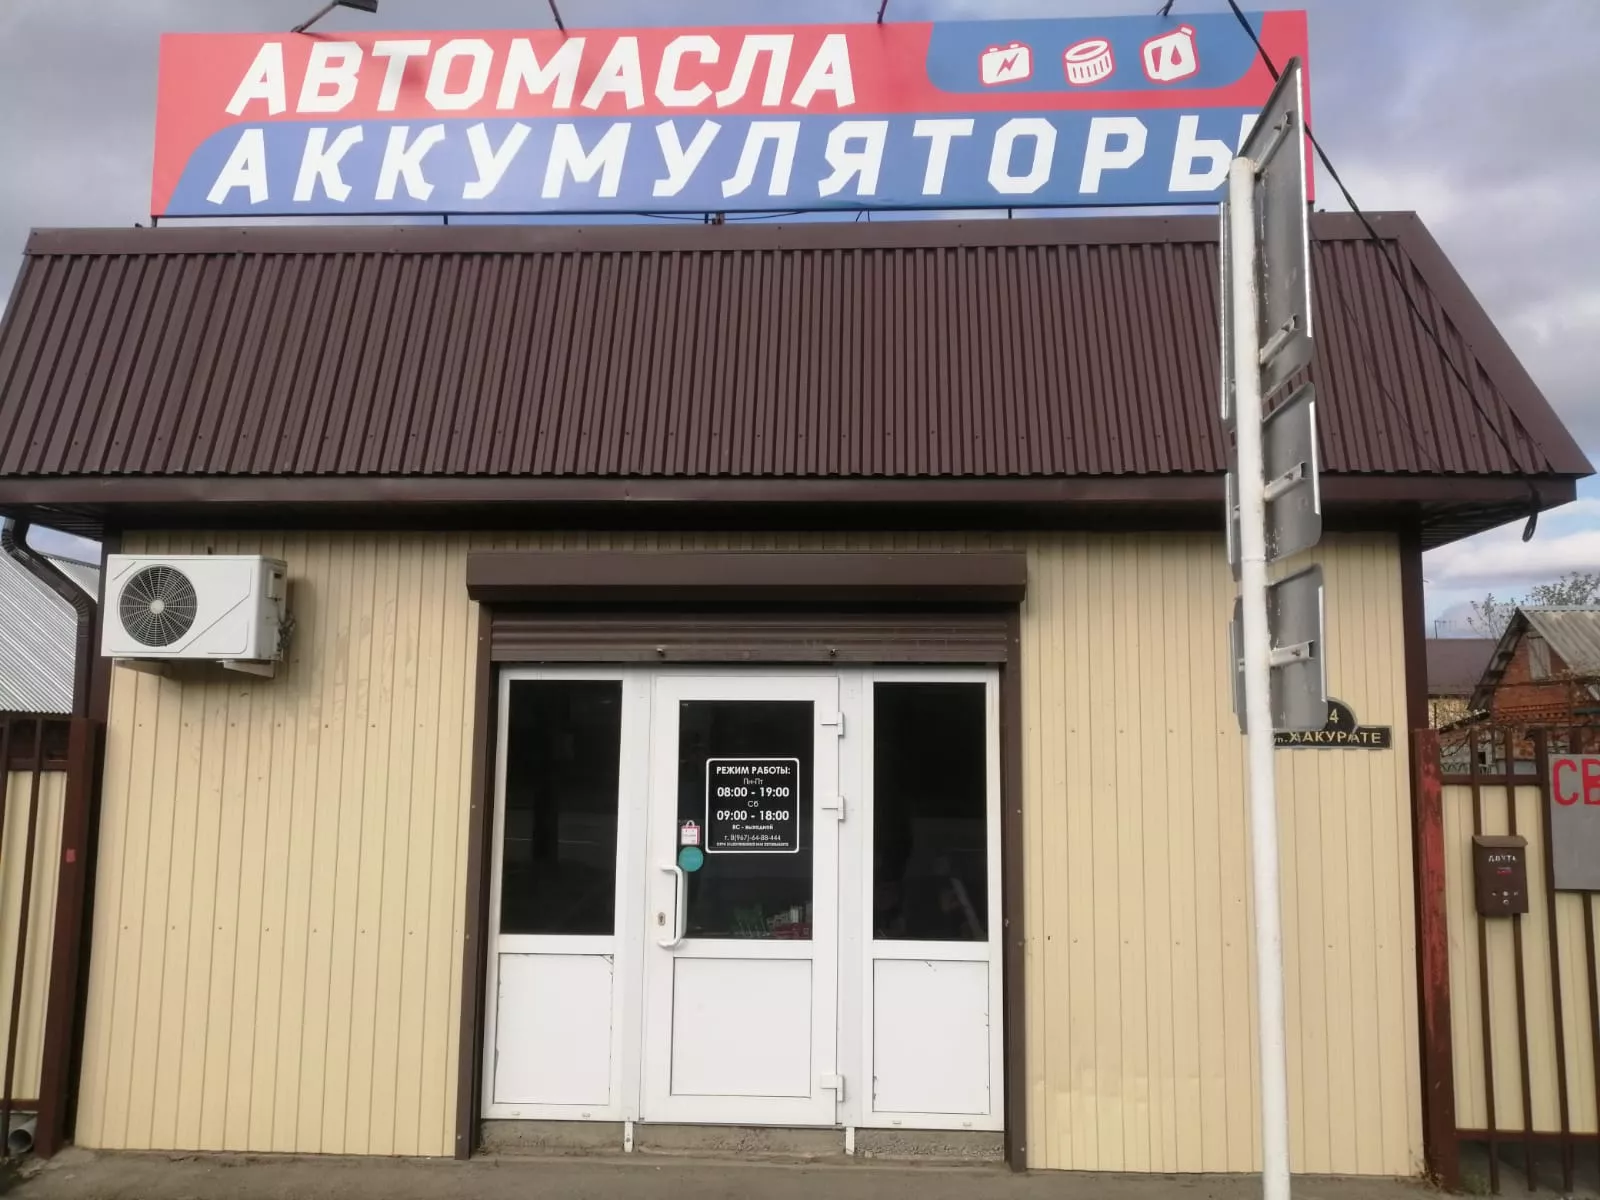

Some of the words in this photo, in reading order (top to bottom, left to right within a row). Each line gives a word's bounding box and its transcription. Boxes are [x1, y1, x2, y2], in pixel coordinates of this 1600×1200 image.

[225, 34, 856, 116] АВТОМАСЛА
[206, 114, 1259, 204] АККУМУЛЯТОРЫ
[1289, 731, 1381, 743] ХАКУРАТЕ
[716, 766, 749, 775] РЕЖИМ
[751, 766, 791, 775] РАБОТЫ:
[717, 787, 748, 797] 08:00
[760, 787, 790, 797] 19:00
[747, 800, 759, 808] Сб
[716, 810, 748, 821] 09:00
[760, 810, 790, 821] 18:00
